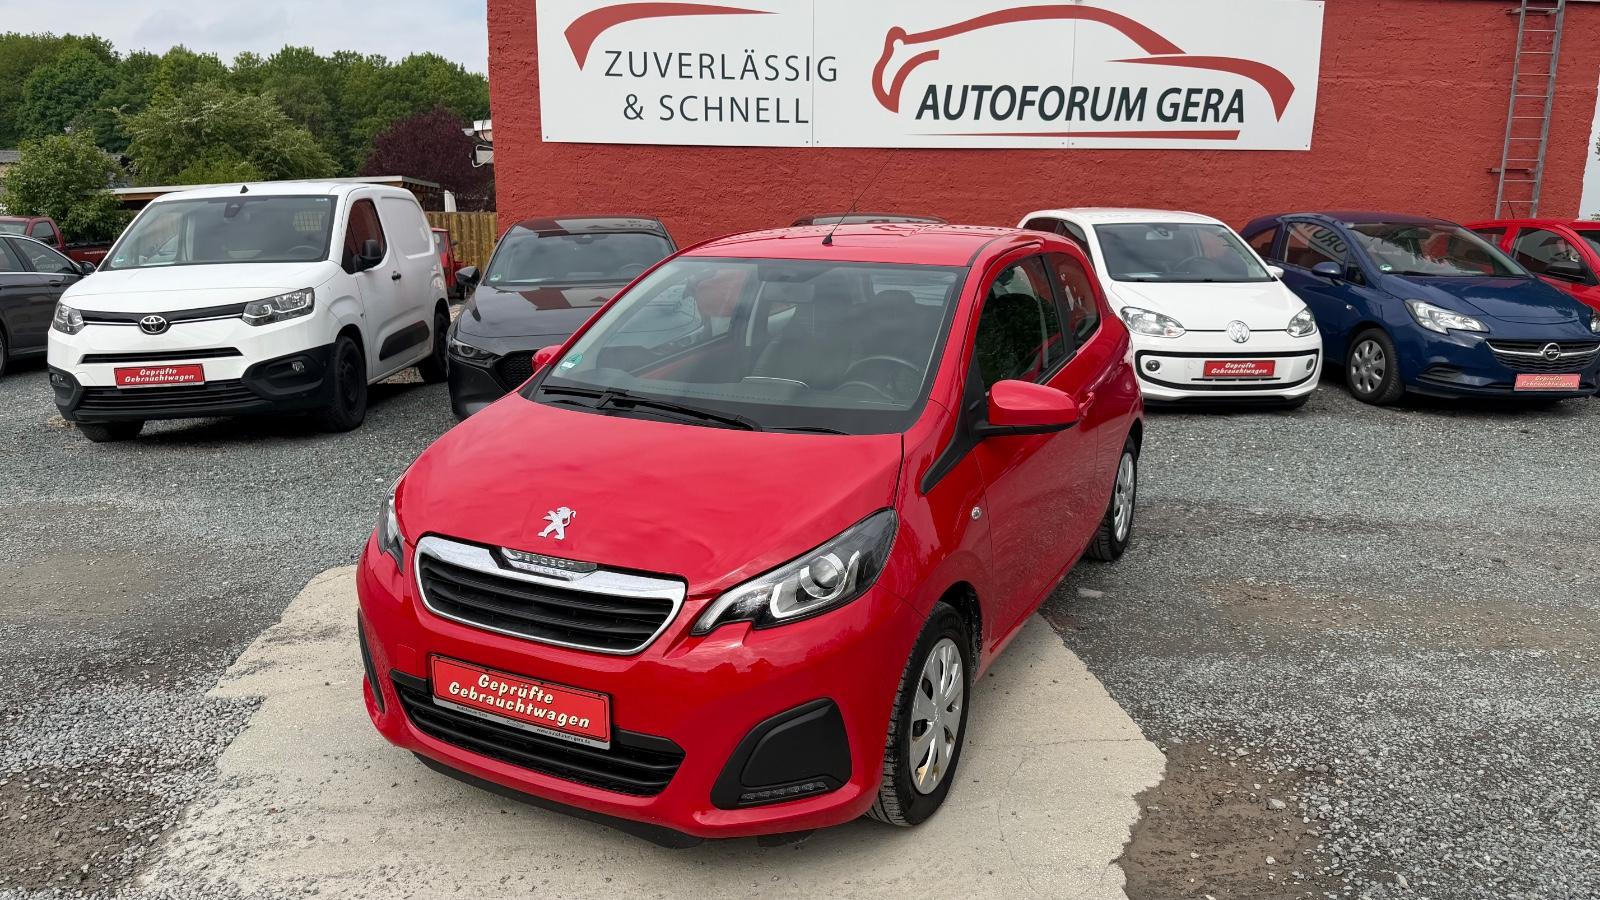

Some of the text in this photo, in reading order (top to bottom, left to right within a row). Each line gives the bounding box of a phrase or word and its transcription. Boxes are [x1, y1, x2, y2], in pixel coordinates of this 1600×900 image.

[604, 49, 838, 82] ZUVERLÄSSIG
[623, 93, 809, 124] & SCHNELL
[915, 84, 1246, 124] AUTOFORUM GERA
[124, 374, 195, 383] Gebrauchtwagen
[140, 367, 177, 377] Geprüfte
[478, 673, 554, 704] Geprüfte
[449, 681, 591, 729] Gebrauchtwagen
